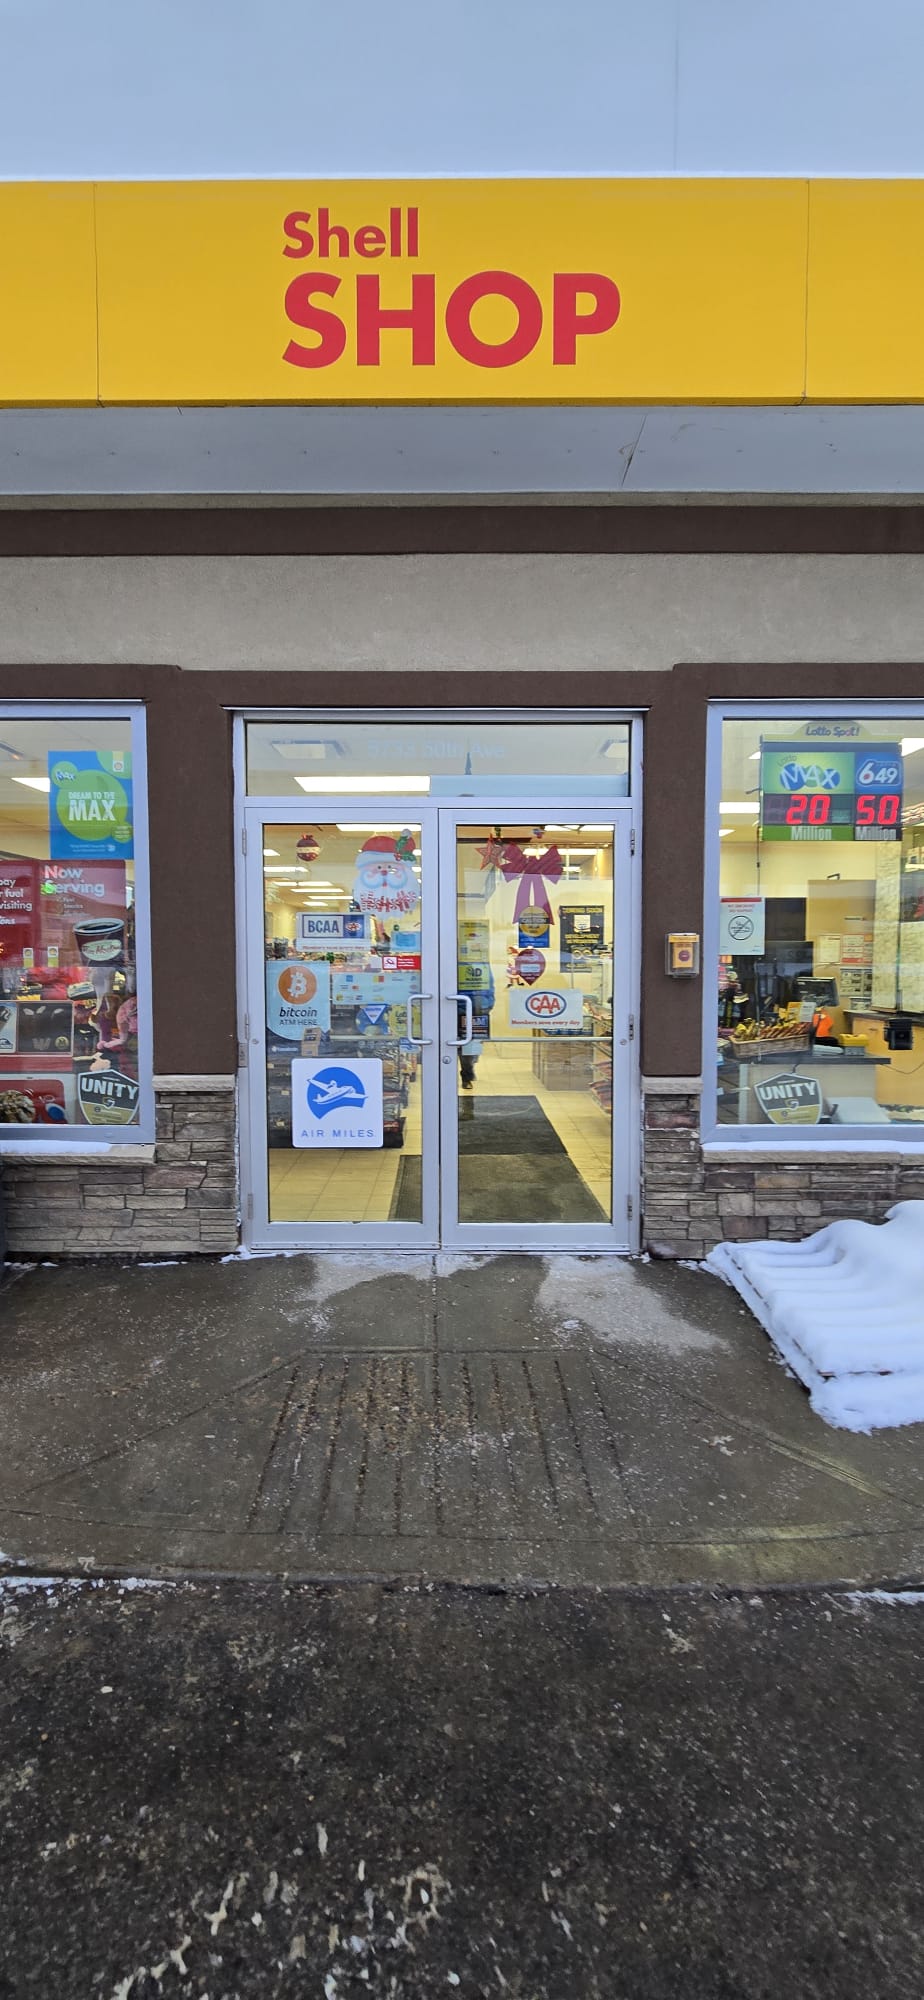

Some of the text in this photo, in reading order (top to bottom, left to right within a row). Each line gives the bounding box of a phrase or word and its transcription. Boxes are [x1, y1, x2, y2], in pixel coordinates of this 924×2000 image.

[282, 207, 419, 259] Shell
[282, 270, 621, 369] SHOP
[805, 726, 860, 738] Lotto Spot!
[781, 761, 838, 791] MAX
[68, 791, 115, 800] DREAM TO THE
[68, 799, 116, 821] MAX
[786, 794, 900, 825] 20 50
[791, 826, 897, 840] Million Million
[44, 865, 84, 879] Now
[5, 888, 24, 898] fuel
[43, 880, 105, 897] Serving
[307, 920, 340, 933] BCAA
[279, 1006, 318, 1017] bitcoin
[530, 995, 561, 1014] CAA
[81, 1076, 138, 1100] UNITY
[759, 1081, 816, 1100] UNITY
[301, 1129, 374, 1138] AIR MILES
